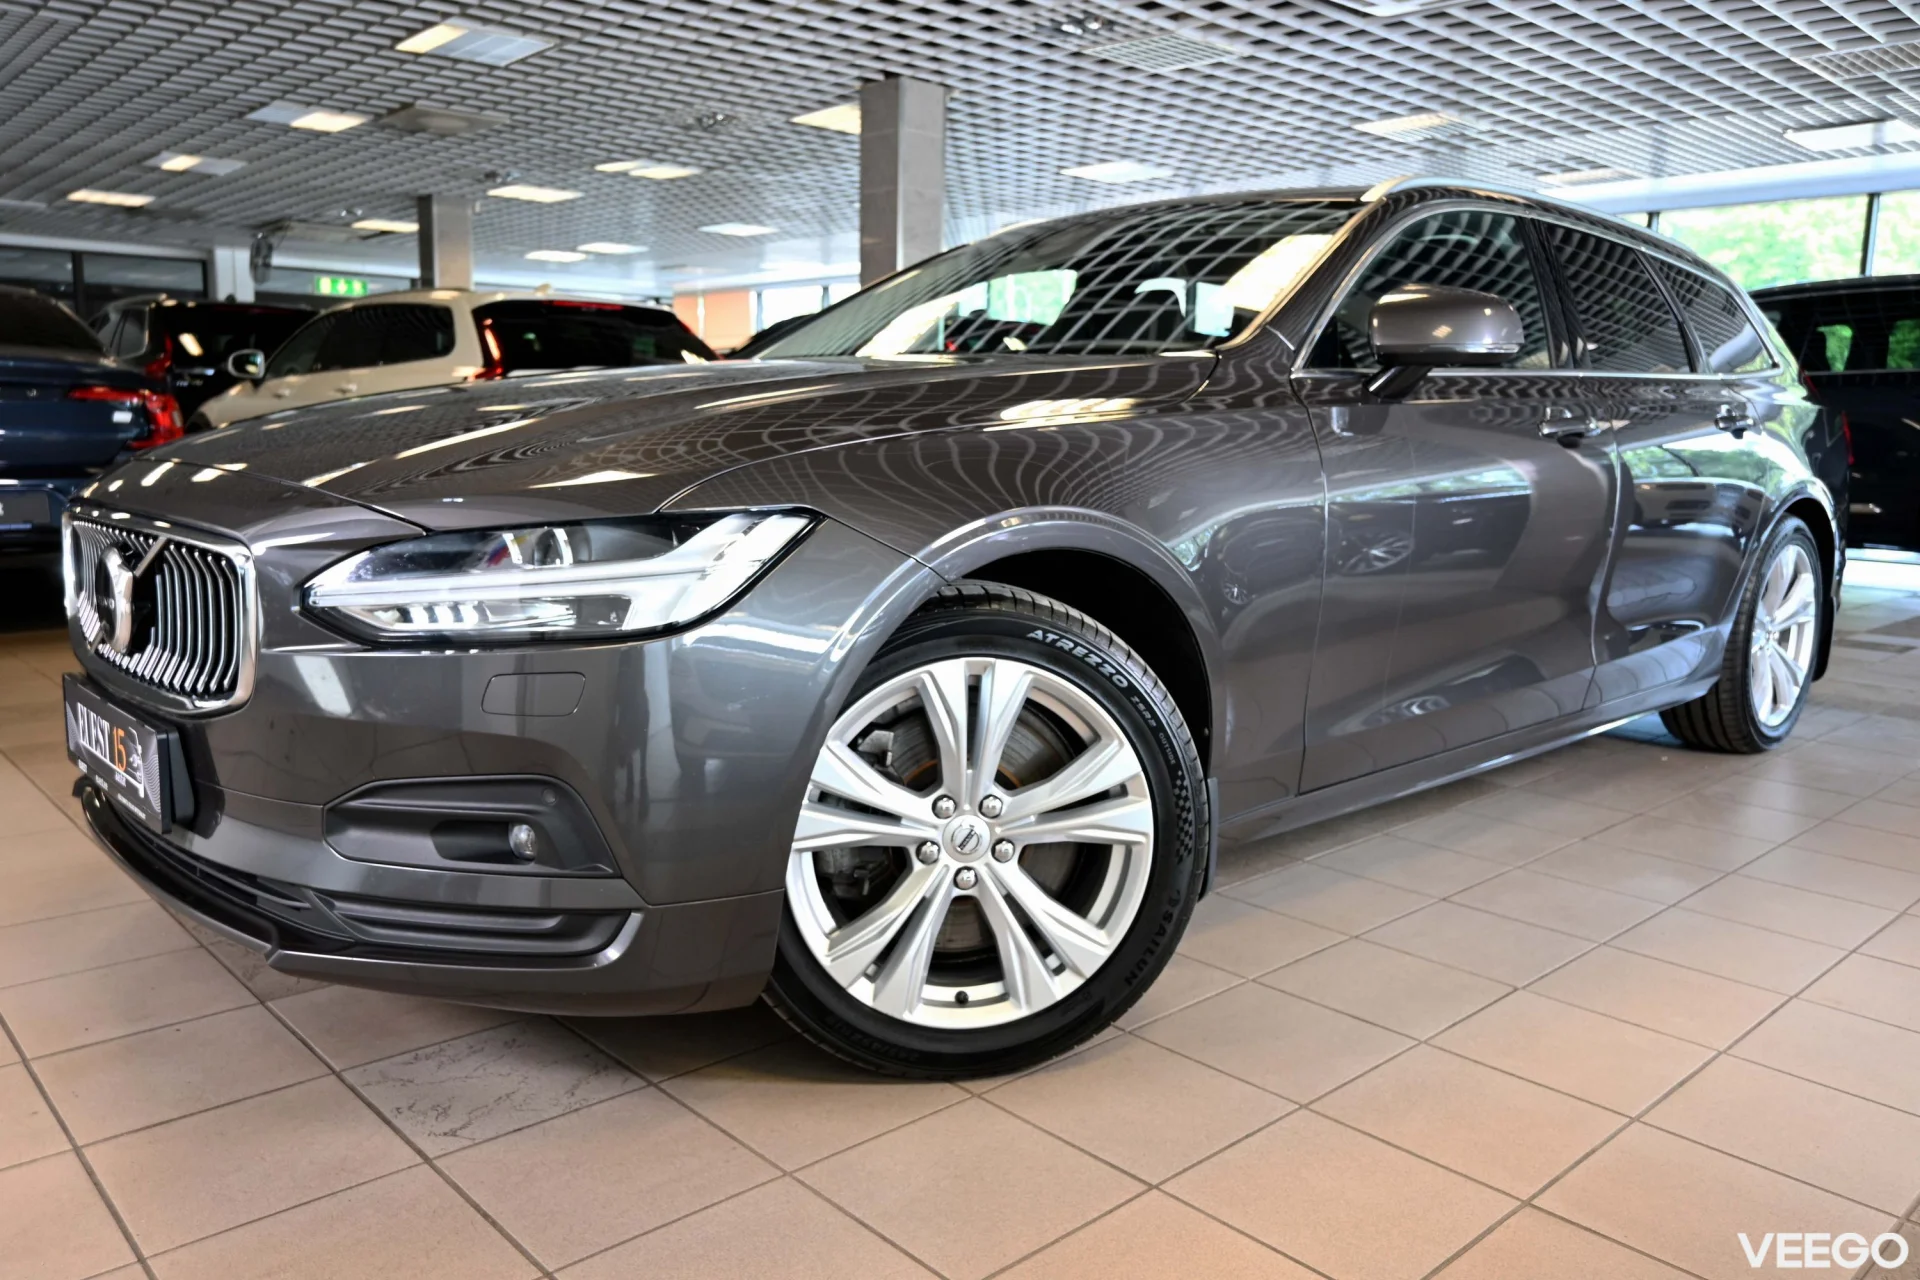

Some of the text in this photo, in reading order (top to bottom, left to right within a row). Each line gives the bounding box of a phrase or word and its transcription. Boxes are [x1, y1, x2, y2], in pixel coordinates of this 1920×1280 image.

[1027, 630, 1129, 688] ATREZZO
[1158, 732, 1176, 765] OUTSIDE
[113, 727, 127, 772] 15
[1125, 910, 1173, 986] SAILUN
